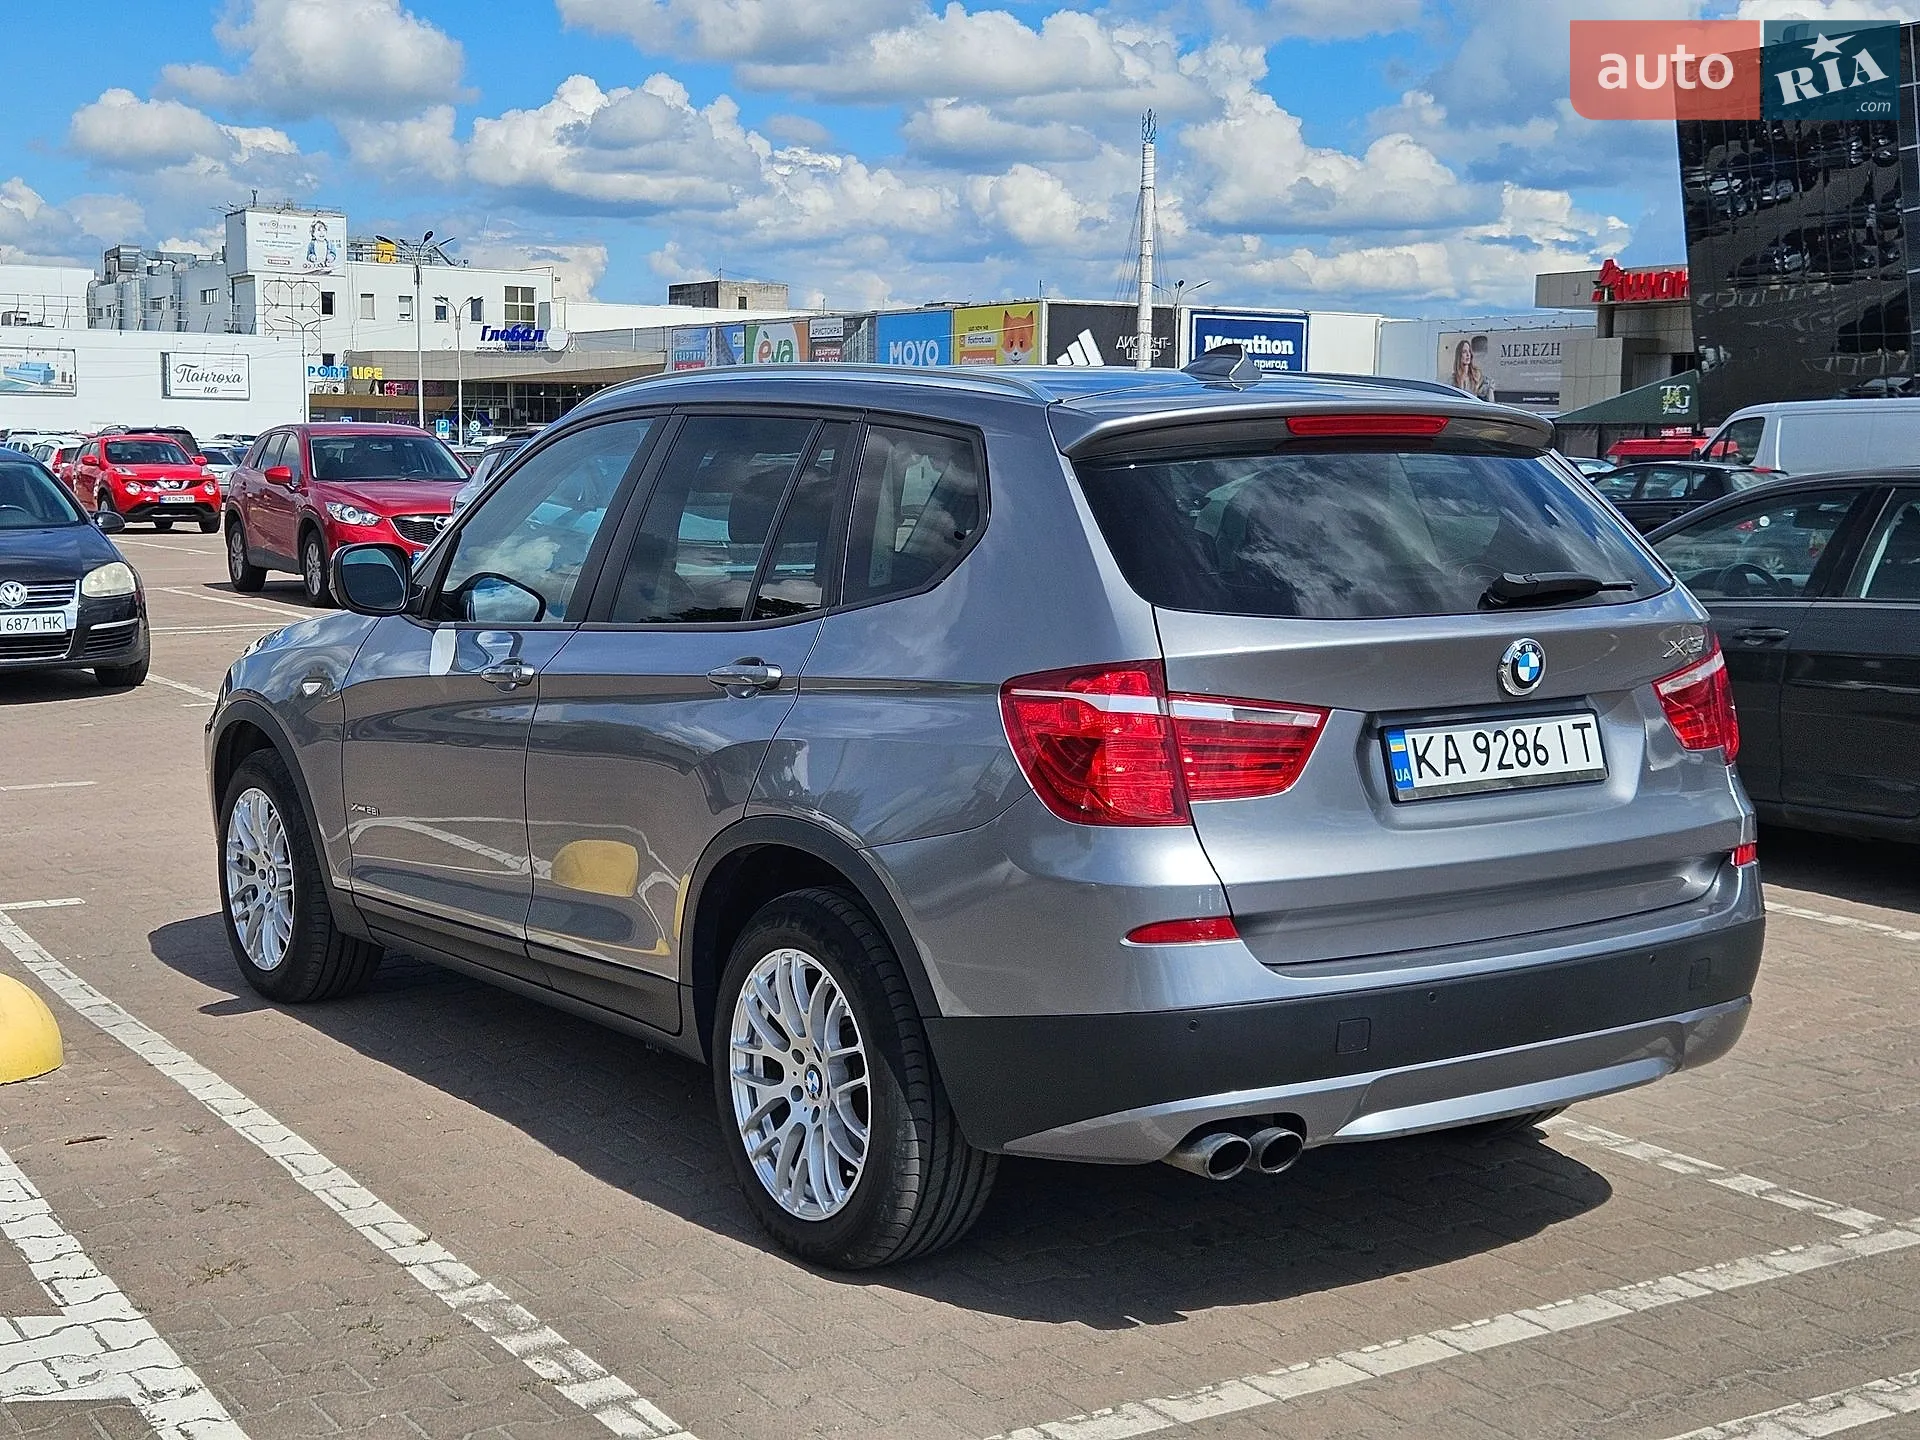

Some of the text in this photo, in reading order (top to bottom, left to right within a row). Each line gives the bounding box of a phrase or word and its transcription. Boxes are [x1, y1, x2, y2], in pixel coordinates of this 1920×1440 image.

[480, 322, 545, 342] Глобал
[1115, 335, 1172, 350] ДИСНТ-
[889, 339, 939, 366] MOYO
[1126, 348, 1161, 361] ЦЕР
[1501, 343, 1561, 358] MEREZH
[175, 364, 243, 384] Панчоха
[352, 366, 384, 380] LIFE
[6, 617, 38, 631] 6871
[42, 616, 62, 630] HK
[1411, 722, 1592, 780] KA 9286 IT
[1395, 768, 1412, 783] UA
